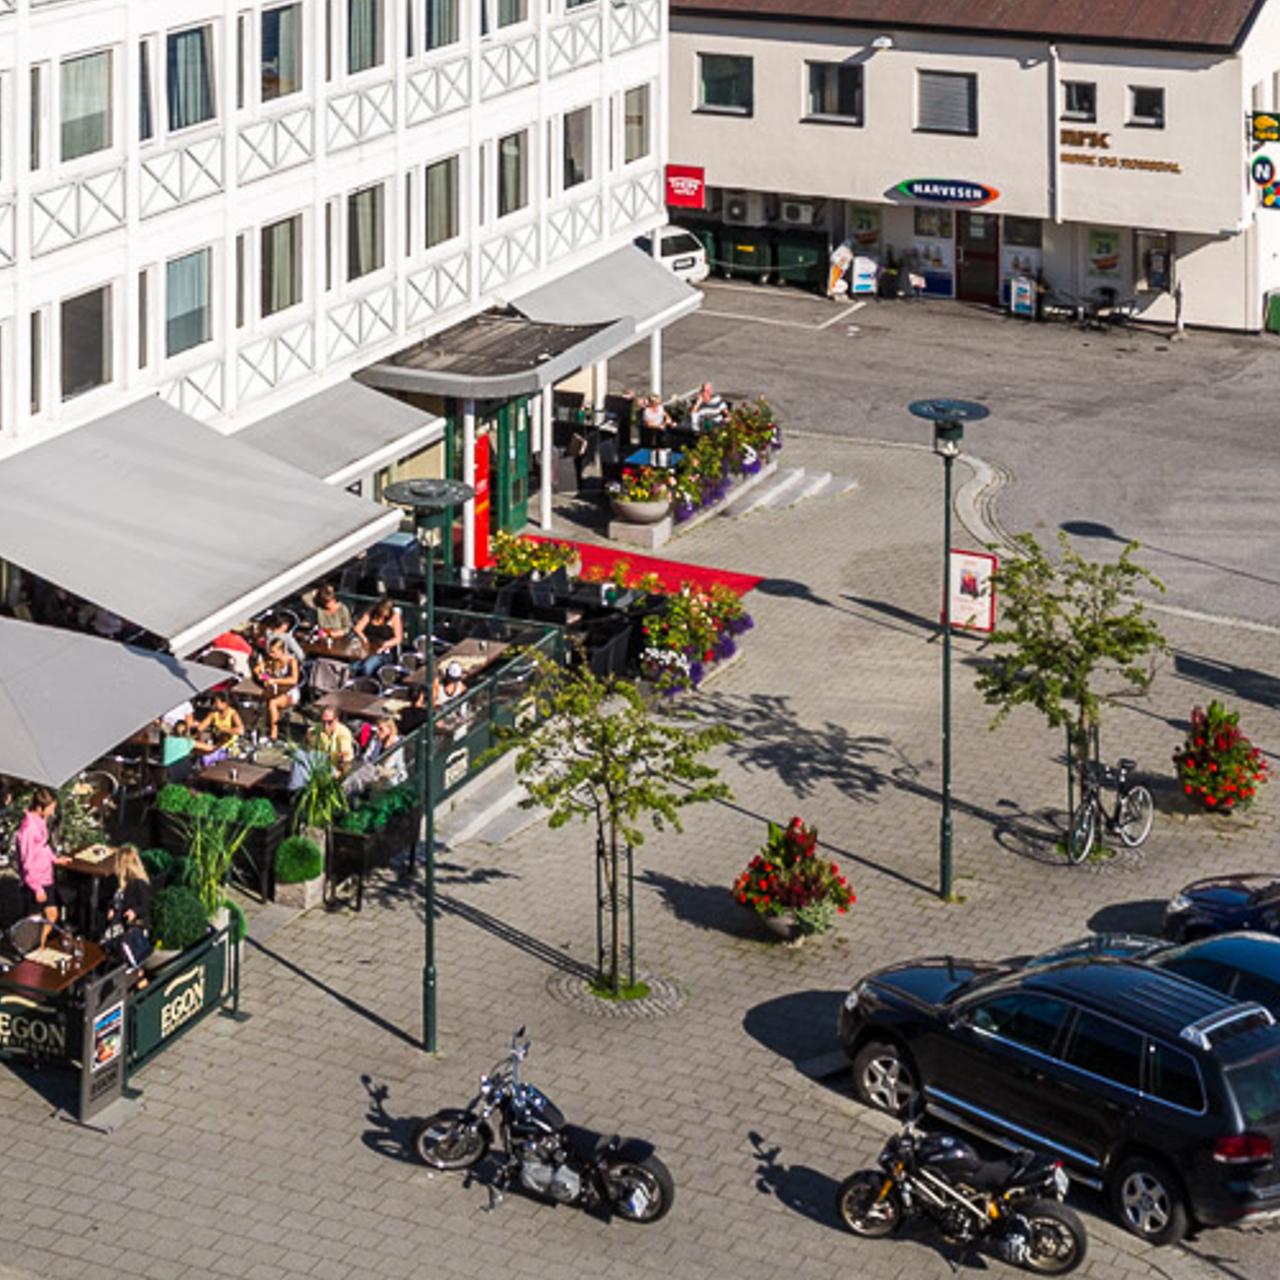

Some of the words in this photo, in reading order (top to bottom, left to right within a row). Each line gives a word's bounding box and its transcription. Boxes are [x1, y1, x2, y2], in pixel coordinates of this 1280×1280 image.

[1254, 163, 1271, 180] N
[913, 184, 982, 199] NARVESEN
[161, 978, 205, 1028] EGON
